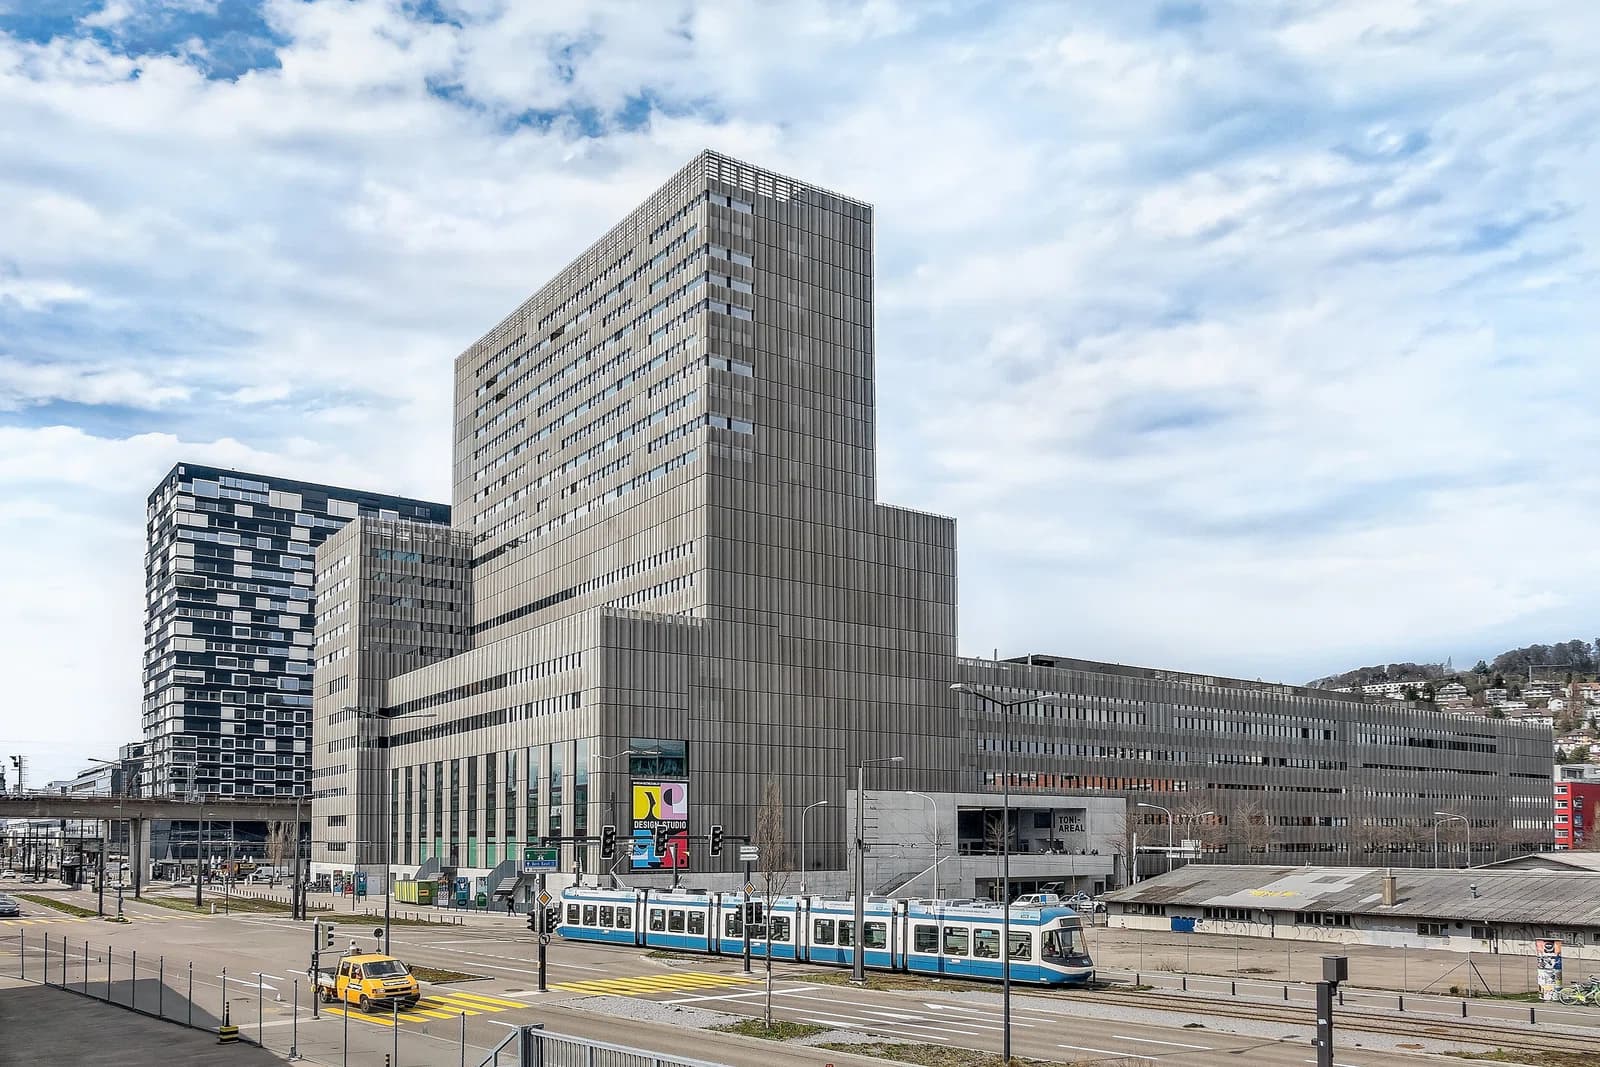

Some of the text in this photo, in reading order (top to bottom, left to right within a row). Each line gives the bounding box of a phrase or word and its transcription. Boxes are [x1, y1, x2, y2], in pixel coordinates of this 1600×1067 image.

[1059, 815, 1081, 824] TONI-
[634, 820, 660, 829] DESIGN
[1058, 824, 1086, 832] AREAL
